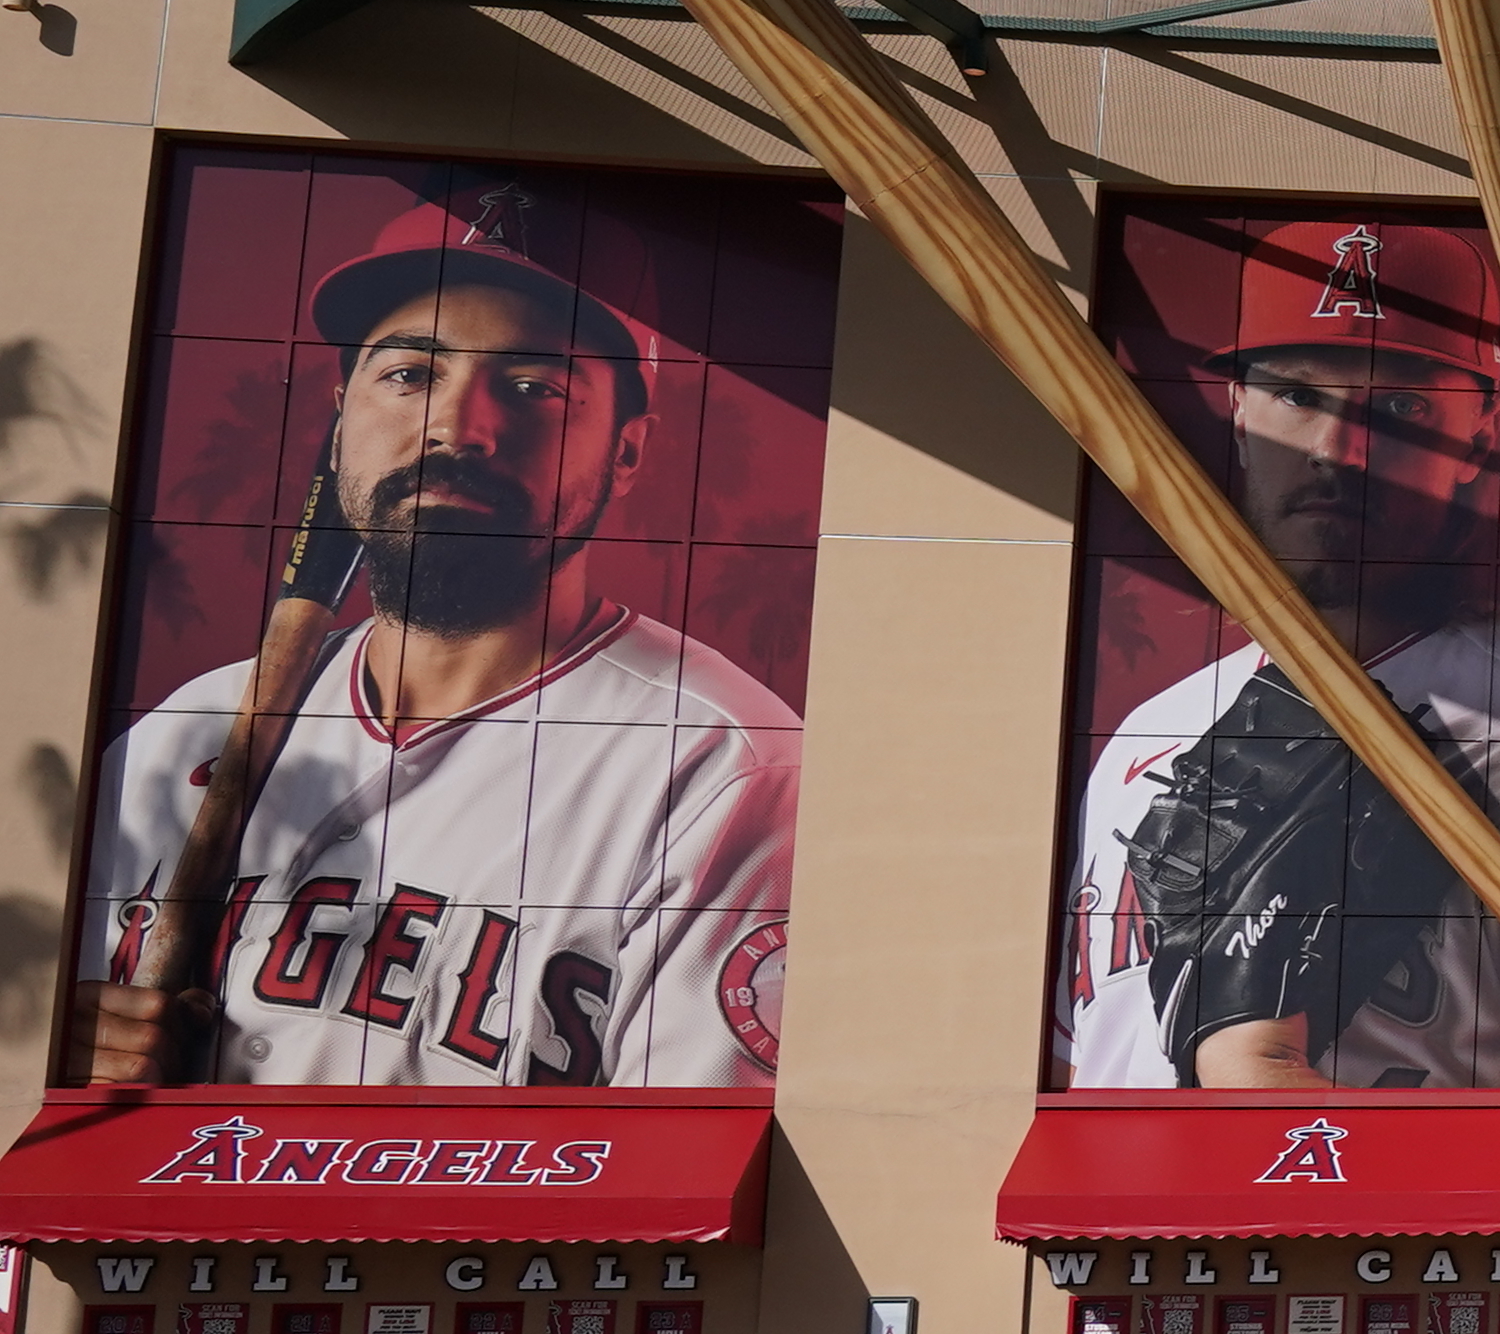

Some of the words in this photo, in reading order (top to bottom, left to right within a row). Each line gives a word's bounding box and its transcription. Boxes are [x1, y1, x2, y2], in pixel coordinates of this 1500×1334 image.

[1309, 223, 1385, 320] A
[1224, 893, 1288, 961] Thor
[725, 986, 755, 1008] 19
[138, 1115, 612, 1186] ANGELS
[1253, 1117, 1349, 1184] A
[97, 1257, 358, 1293] WILL
[445, 1255, 696, 1291] CALL
[1046, 1250, 1280, 1286] WILL
